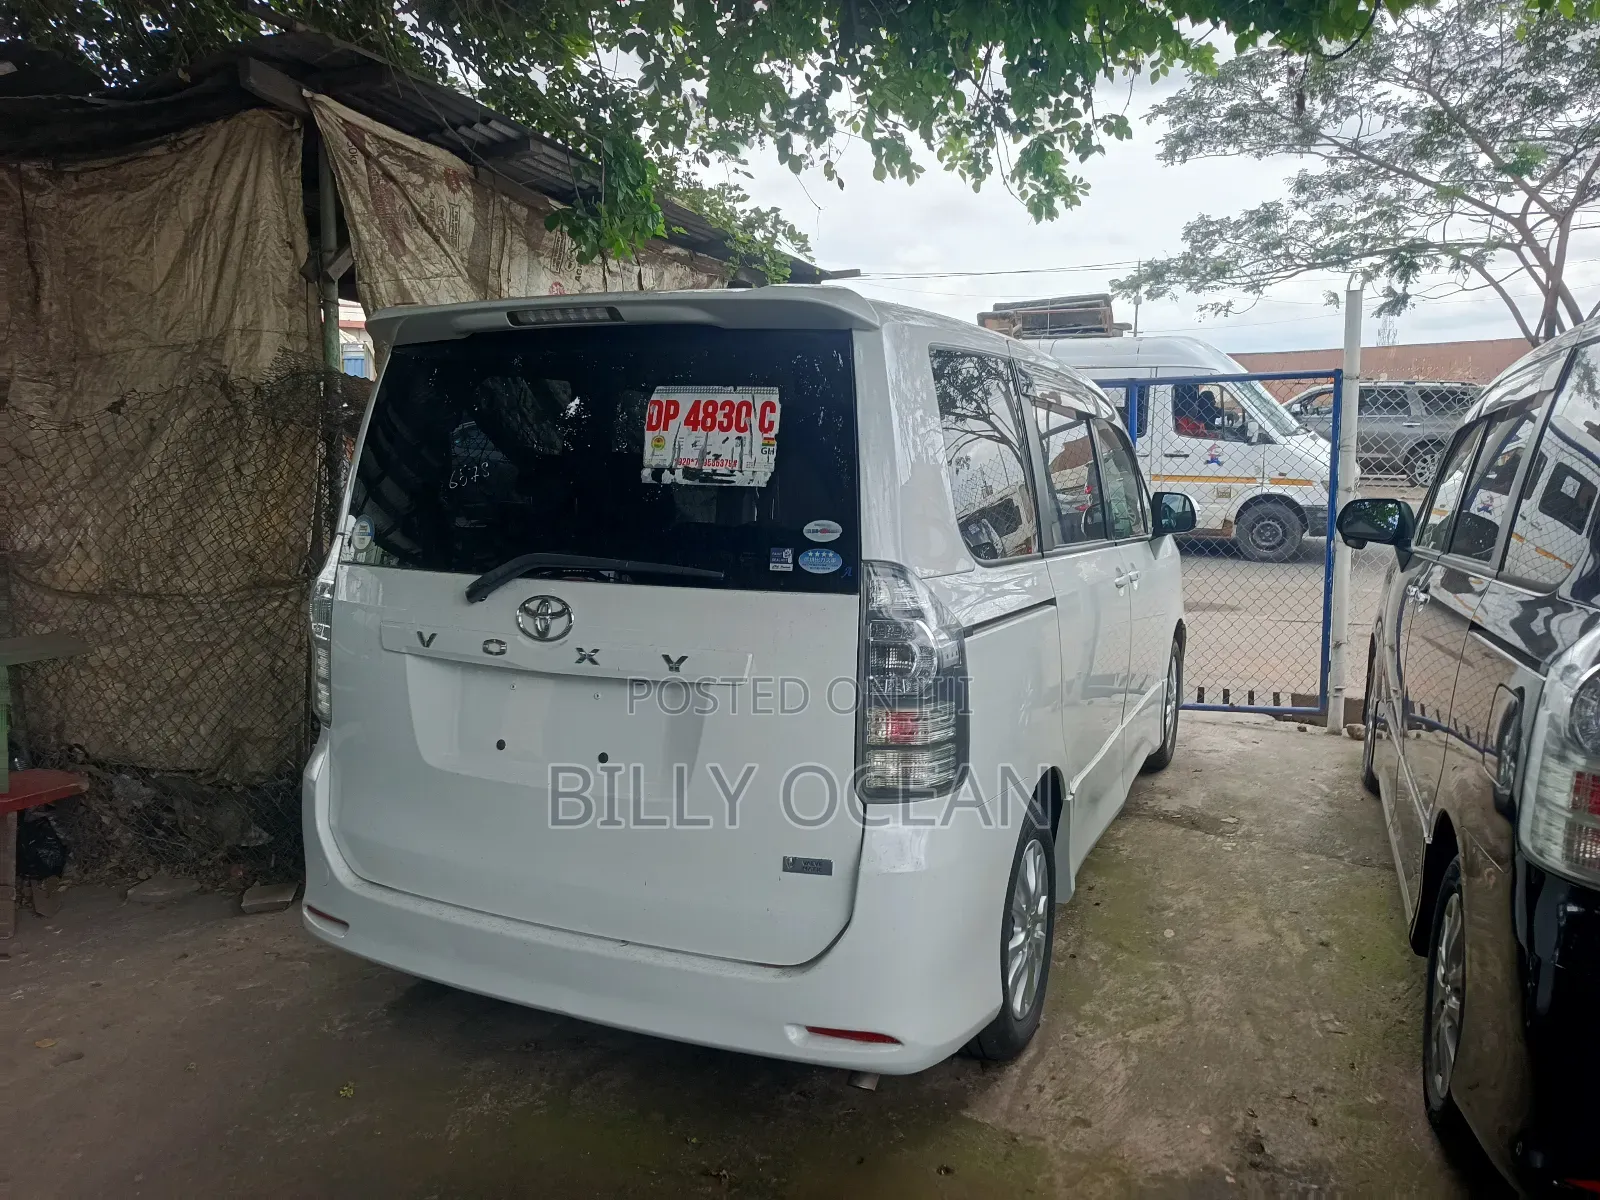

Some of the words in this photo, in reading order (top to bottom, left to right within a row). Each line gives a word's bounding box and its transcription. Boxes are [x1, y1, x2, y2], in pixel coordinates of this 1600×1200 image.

[645, 399, 681, 432] DP
[684, 399, 752, 434] 4830
[758, 400, 776, 434] C
[761, 447, 775, 455] GH
